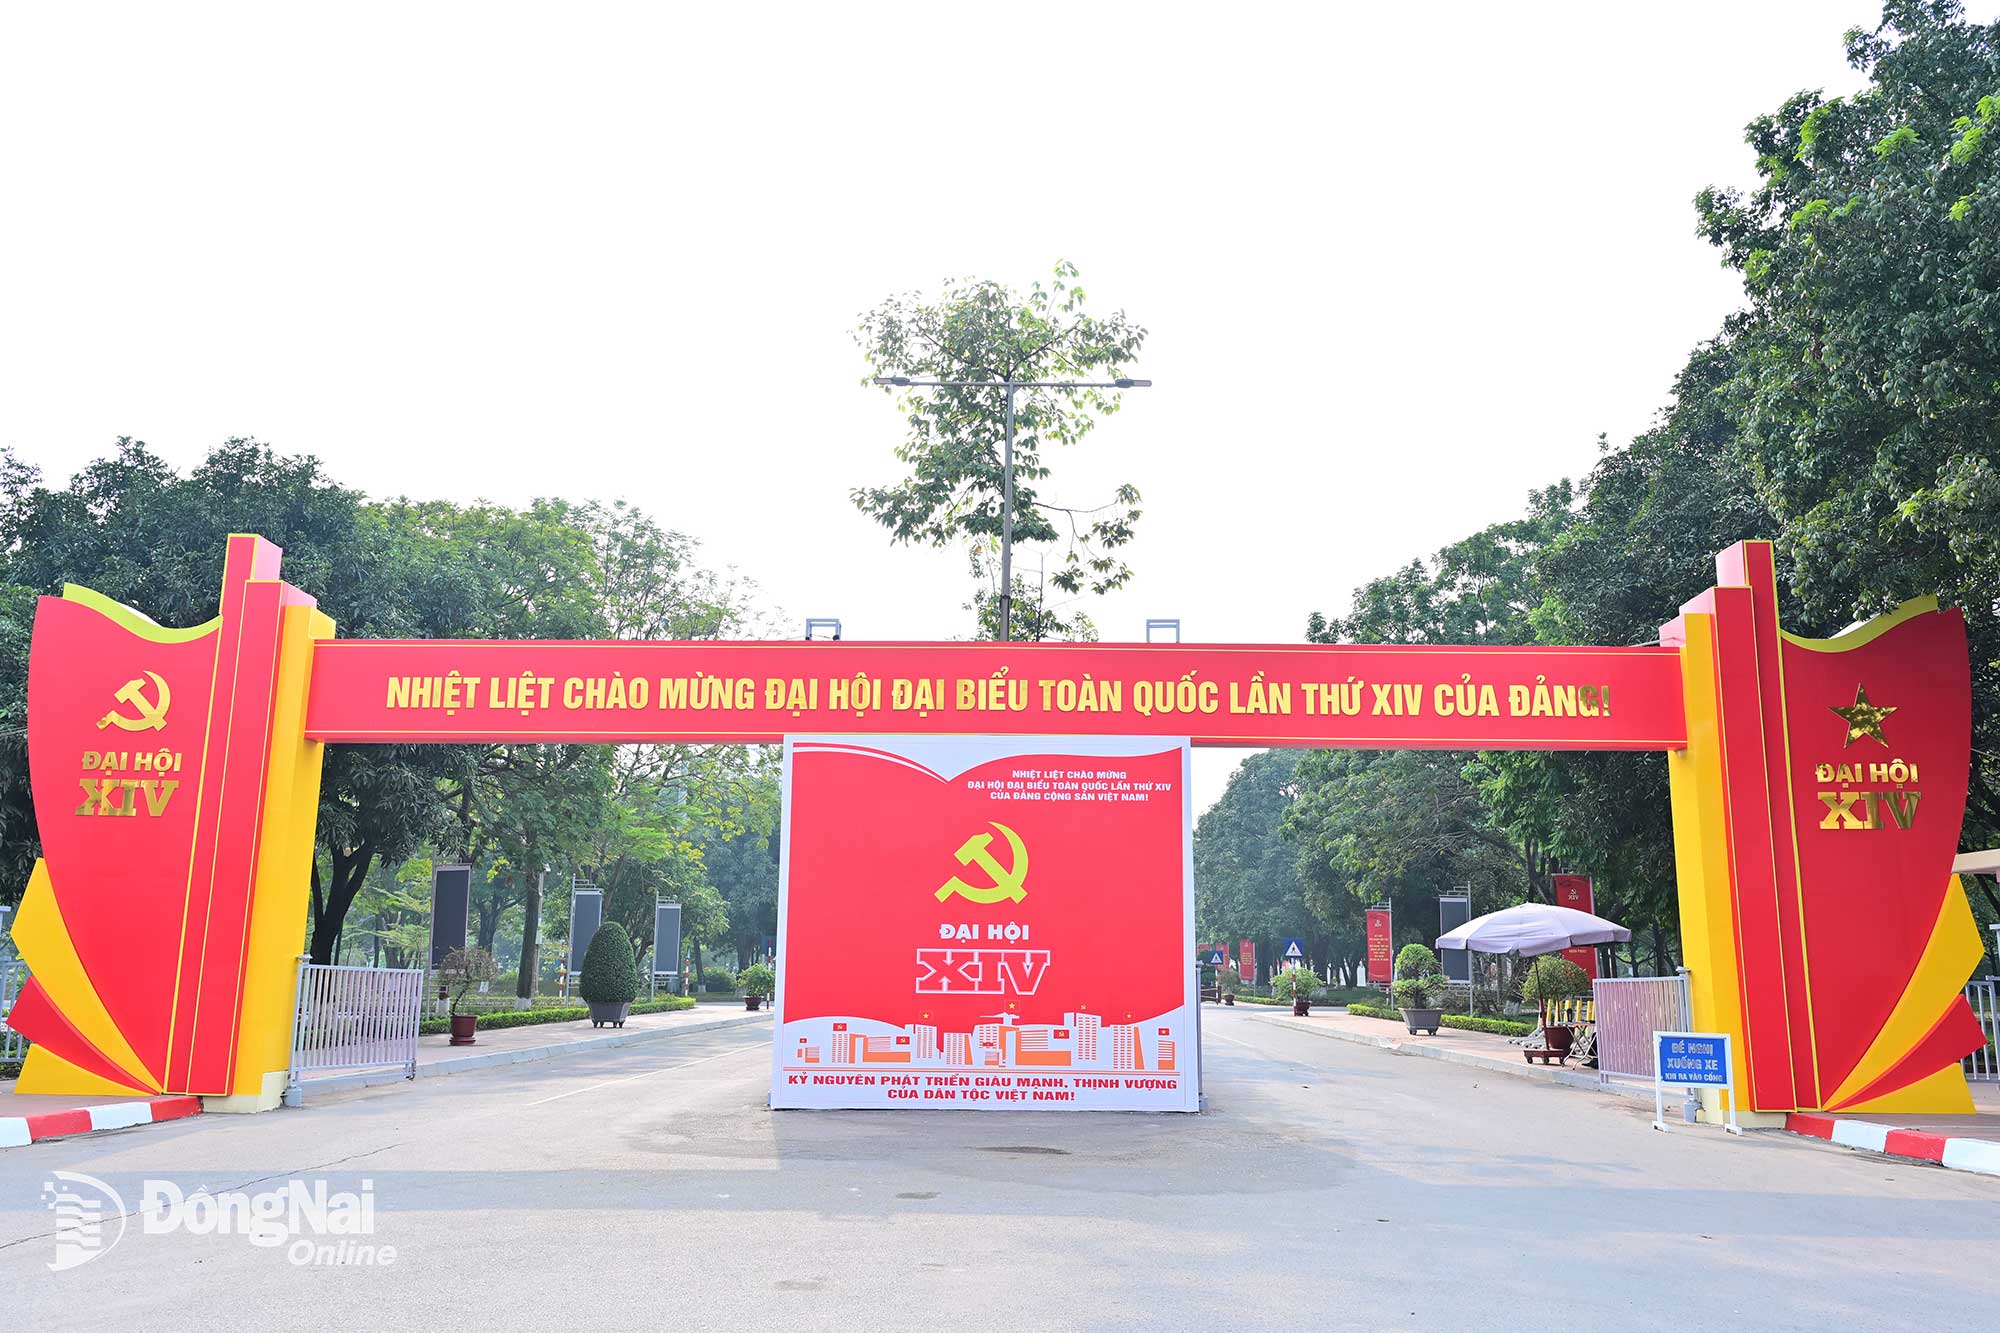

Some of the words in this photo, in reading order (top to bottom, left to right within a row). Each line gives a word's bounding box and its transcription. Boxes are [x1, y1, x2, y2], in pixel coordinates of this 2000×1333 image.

[386, 669, 481, 716] NHIỆT
[488, 670, 555, 716] LIỆT
[563, 671, 649, 710] CHÀO
[659, 671, 755, 710] MỪNG
[764, 678, 818, 717] ĐẠI
[828, 671, 882, 718] HỘI
[891, 678, 945, 718] ĐẠI
[956, 665, 1029, 711] BIỂU
[1038, 673, 1122, 712] TOÀN
[1133, 669, 1219, 717] QUỐC
[1229, 670, 1292, 715] LẦN
[1300, 675, 1365, 716] THỨ
[1370, 683, 1423, 716] XIV
[1433, 672, 1500, 717] CỦA
[1508, 674, 1611, 717] ĐẢNG!
[81, 751, 129, 776] ĐẠI
[133, 747, 182, 777] HỘI
[1012, 769, 1042, 780] NHIỆT
[1043, 769, 1065, 781] LIỆT
[1066, 769, 1094, 780] CHÀO
[1814, 762, 1863, 789] ĐẠI
[1868, 758, 1919, 789] HỘI
[967, 780, 985, 791] ĐẠI
[987, 779, 1005, 791] HỘI
[1006, 781, 1024, 791] ĐẠI
[1052, 780, 1079, 790] TOÀN
[1155, 783, 1172, 791] XIV
[74, 778, 180, 817] XIV
[990, 790, 1011, 800] CỦA
[1043, 791, 1072, 802] CỘNG
[1097, 791, 1119, 802] VIỆT
[1121, 793, 1149, 801] NAM!
[1817, 792, 1921, 829] XIV
[939, 923, 980, 944] ĐẠI
[987, 921, 1029, 945] HỘI
[915, 948, 1051, 995] XIV
[1705, 1060, 1718, 1071] XE
[813, 1073, 876, 1086] NGUYÊN
[1072, 1078, 1120, 1091] THỊNH
[1124, 1078, 1178, 1092] VƯỢNG
[1679, 1073, 1687, 1081] RA
[923, 1088, 956, 1100] DÂN
[960, 1088, 991, 1102] TỘC
[994, 1088, 1028, 1103] VIỆT
[1032, 1090, 1075, 1101] NAM!
